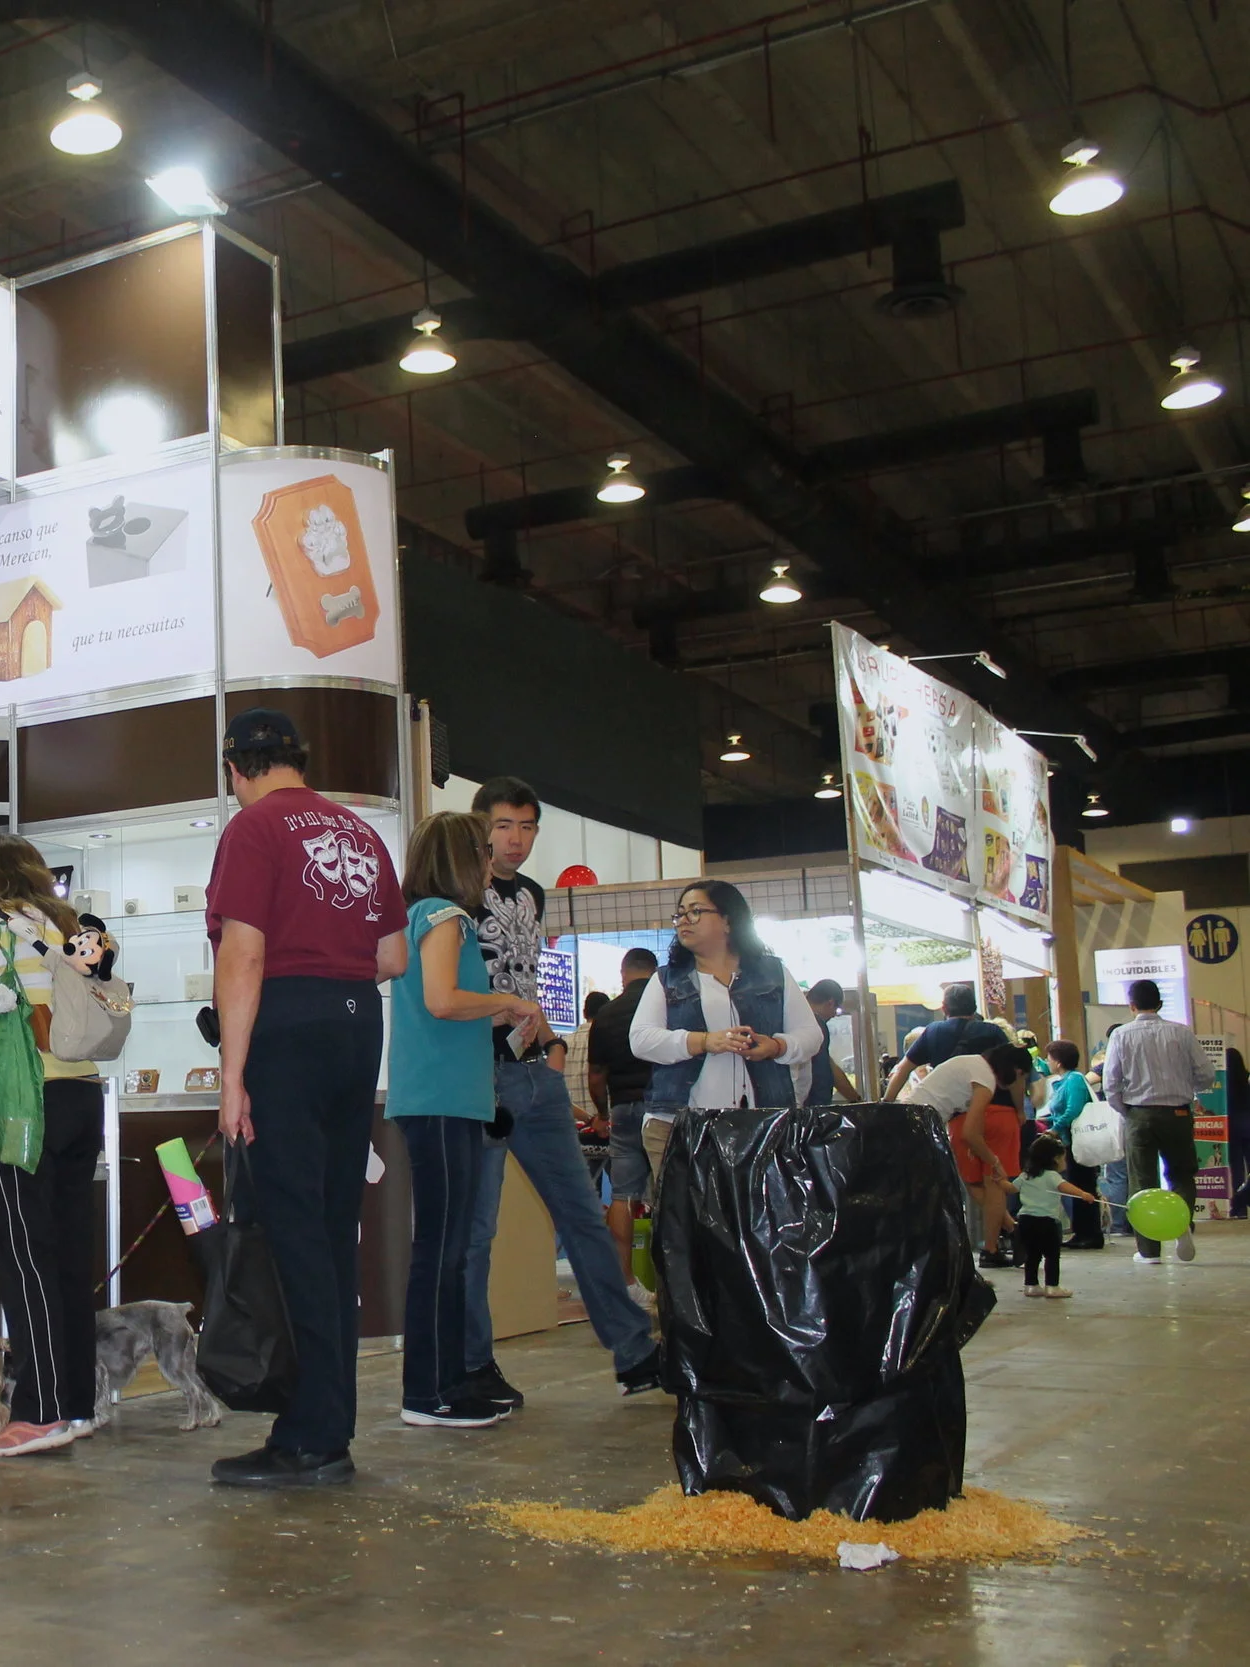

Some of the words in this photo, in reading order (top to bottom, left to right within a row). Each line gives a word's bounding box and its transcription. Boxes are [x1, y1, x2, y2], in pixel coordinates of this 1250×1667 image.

[36, 522, 59, 539] que
[71, 634, 95, 652] que
[98, 630, 113, 643] tu
[284, 814, 306, 831] It's
